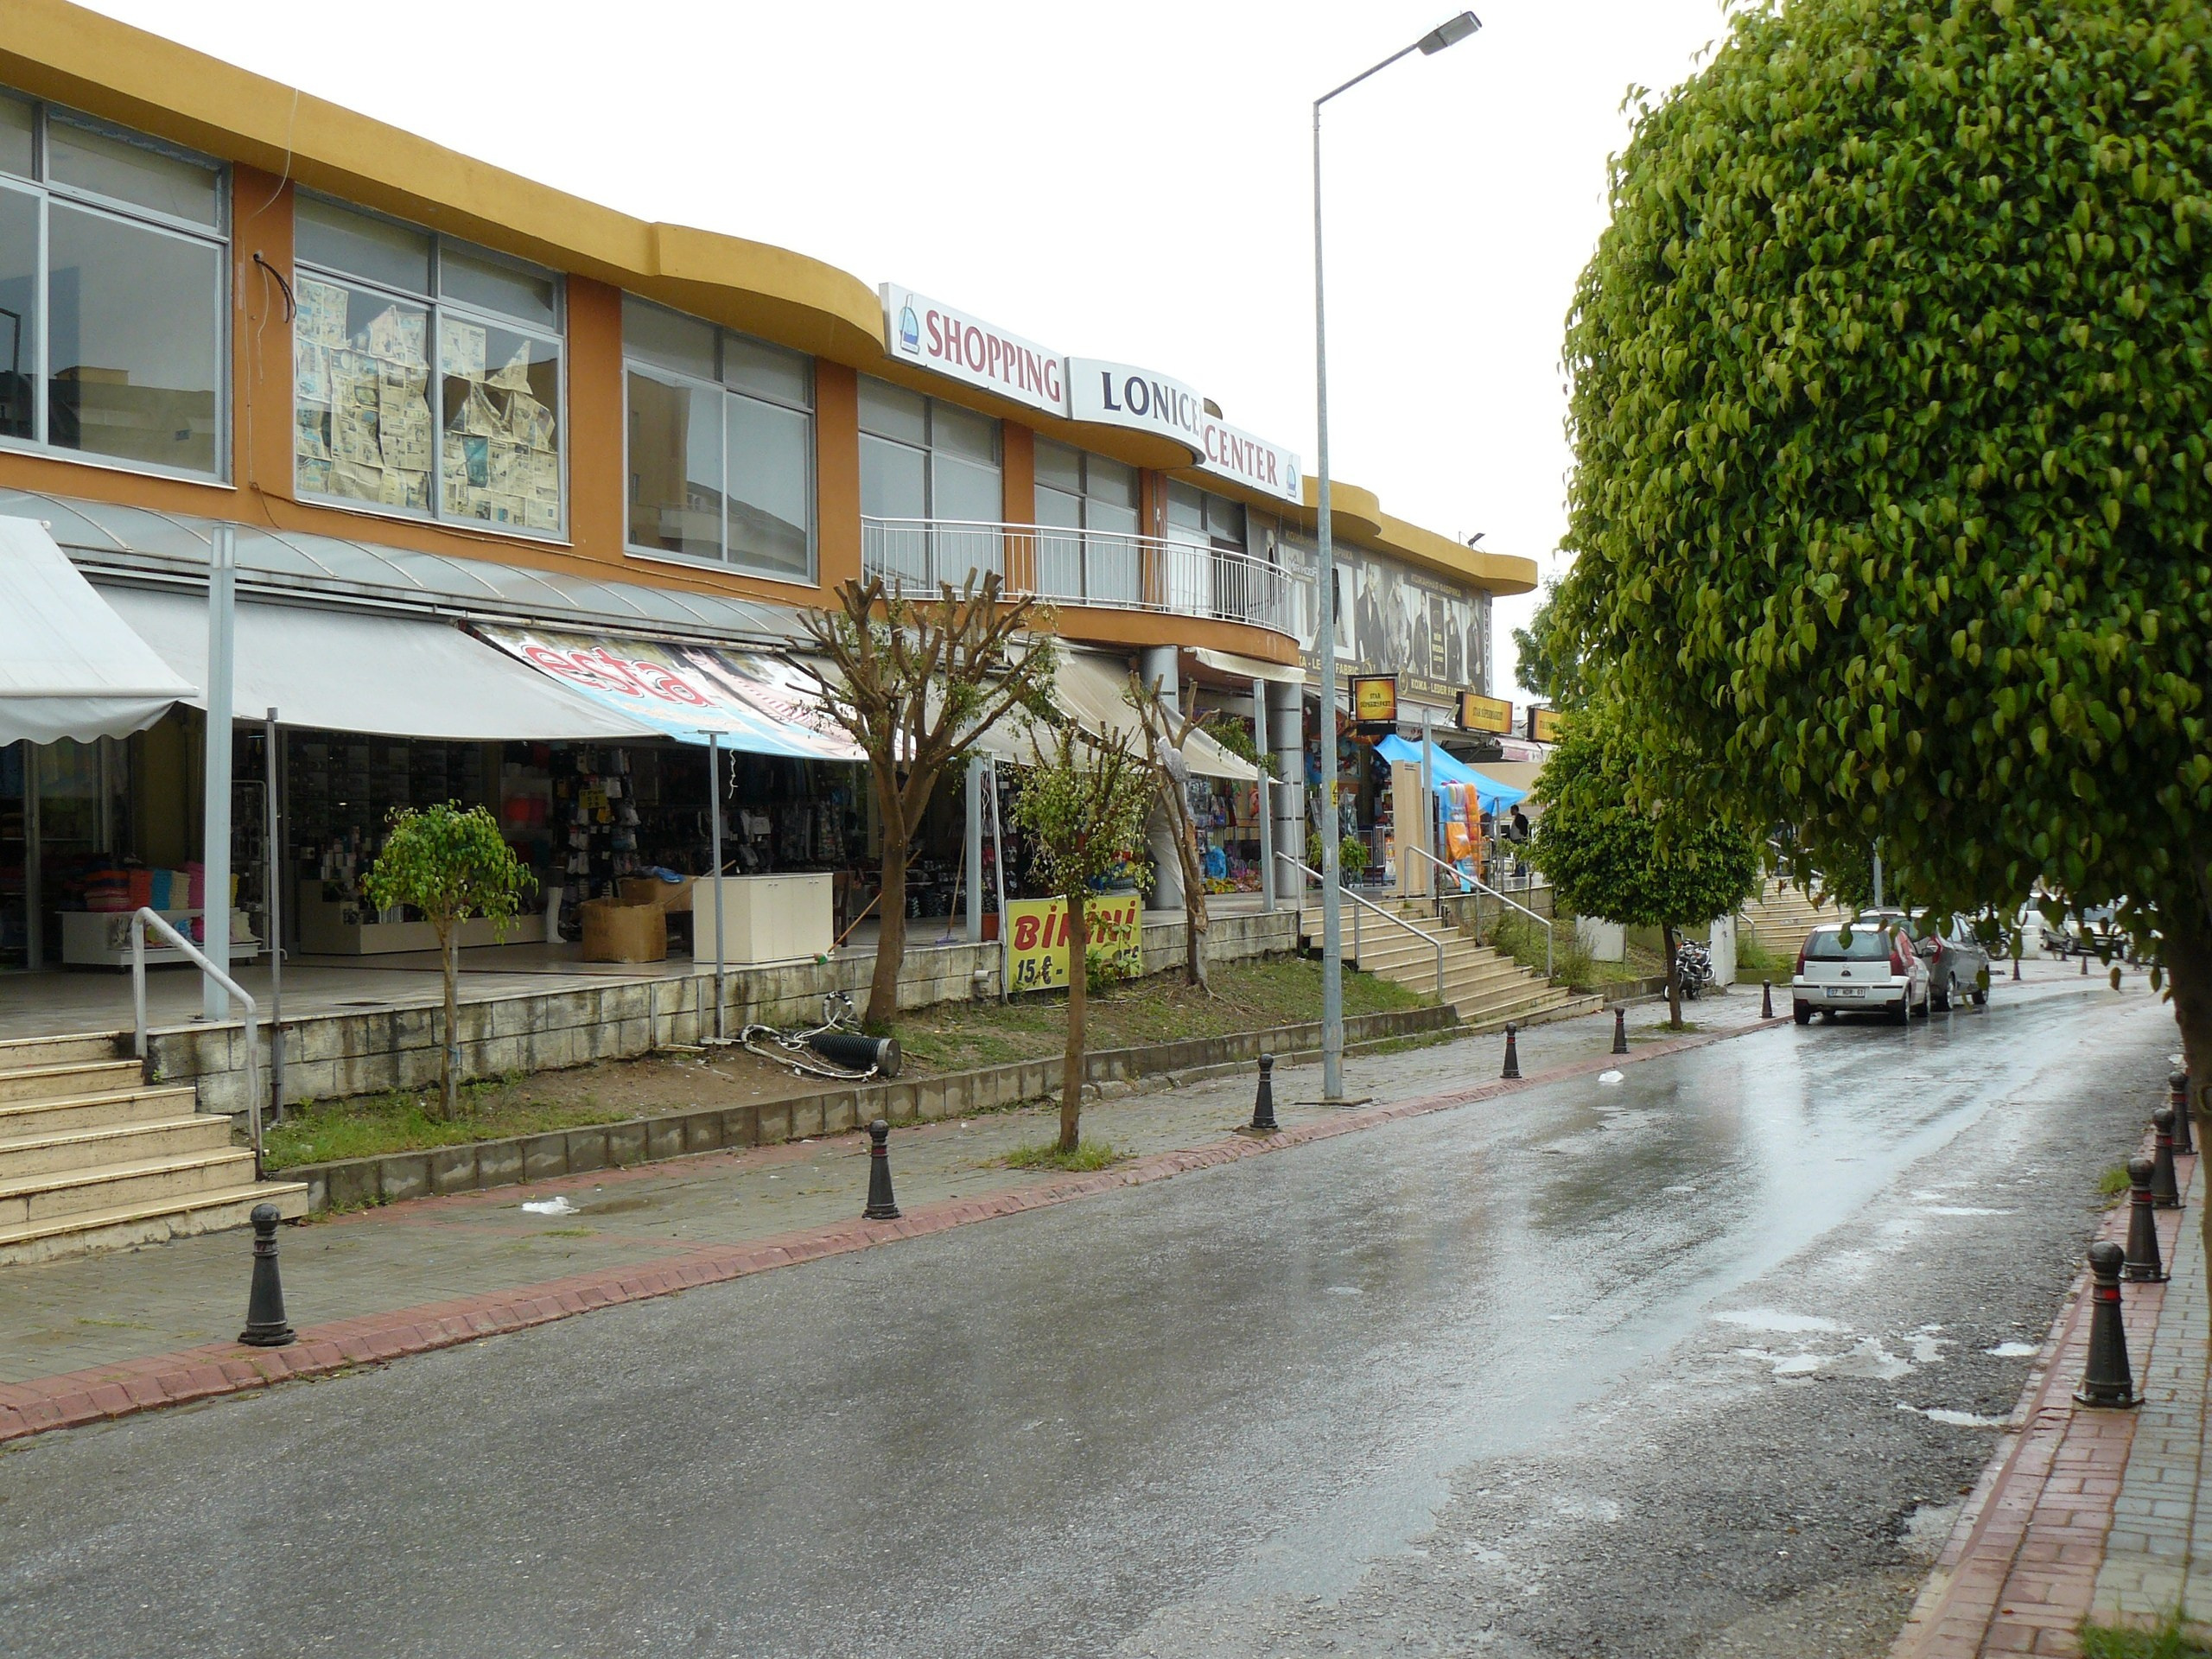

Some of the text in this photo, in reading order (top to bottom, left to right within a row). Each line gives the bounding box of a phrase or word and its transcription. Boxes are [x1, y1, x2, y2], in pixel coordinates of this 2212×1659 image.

[926, 309, 1060, 403] SHOPPING
[1205, 424, 1278, 486] CENTER
[1335, 662, 1358, 676] FABRIC
